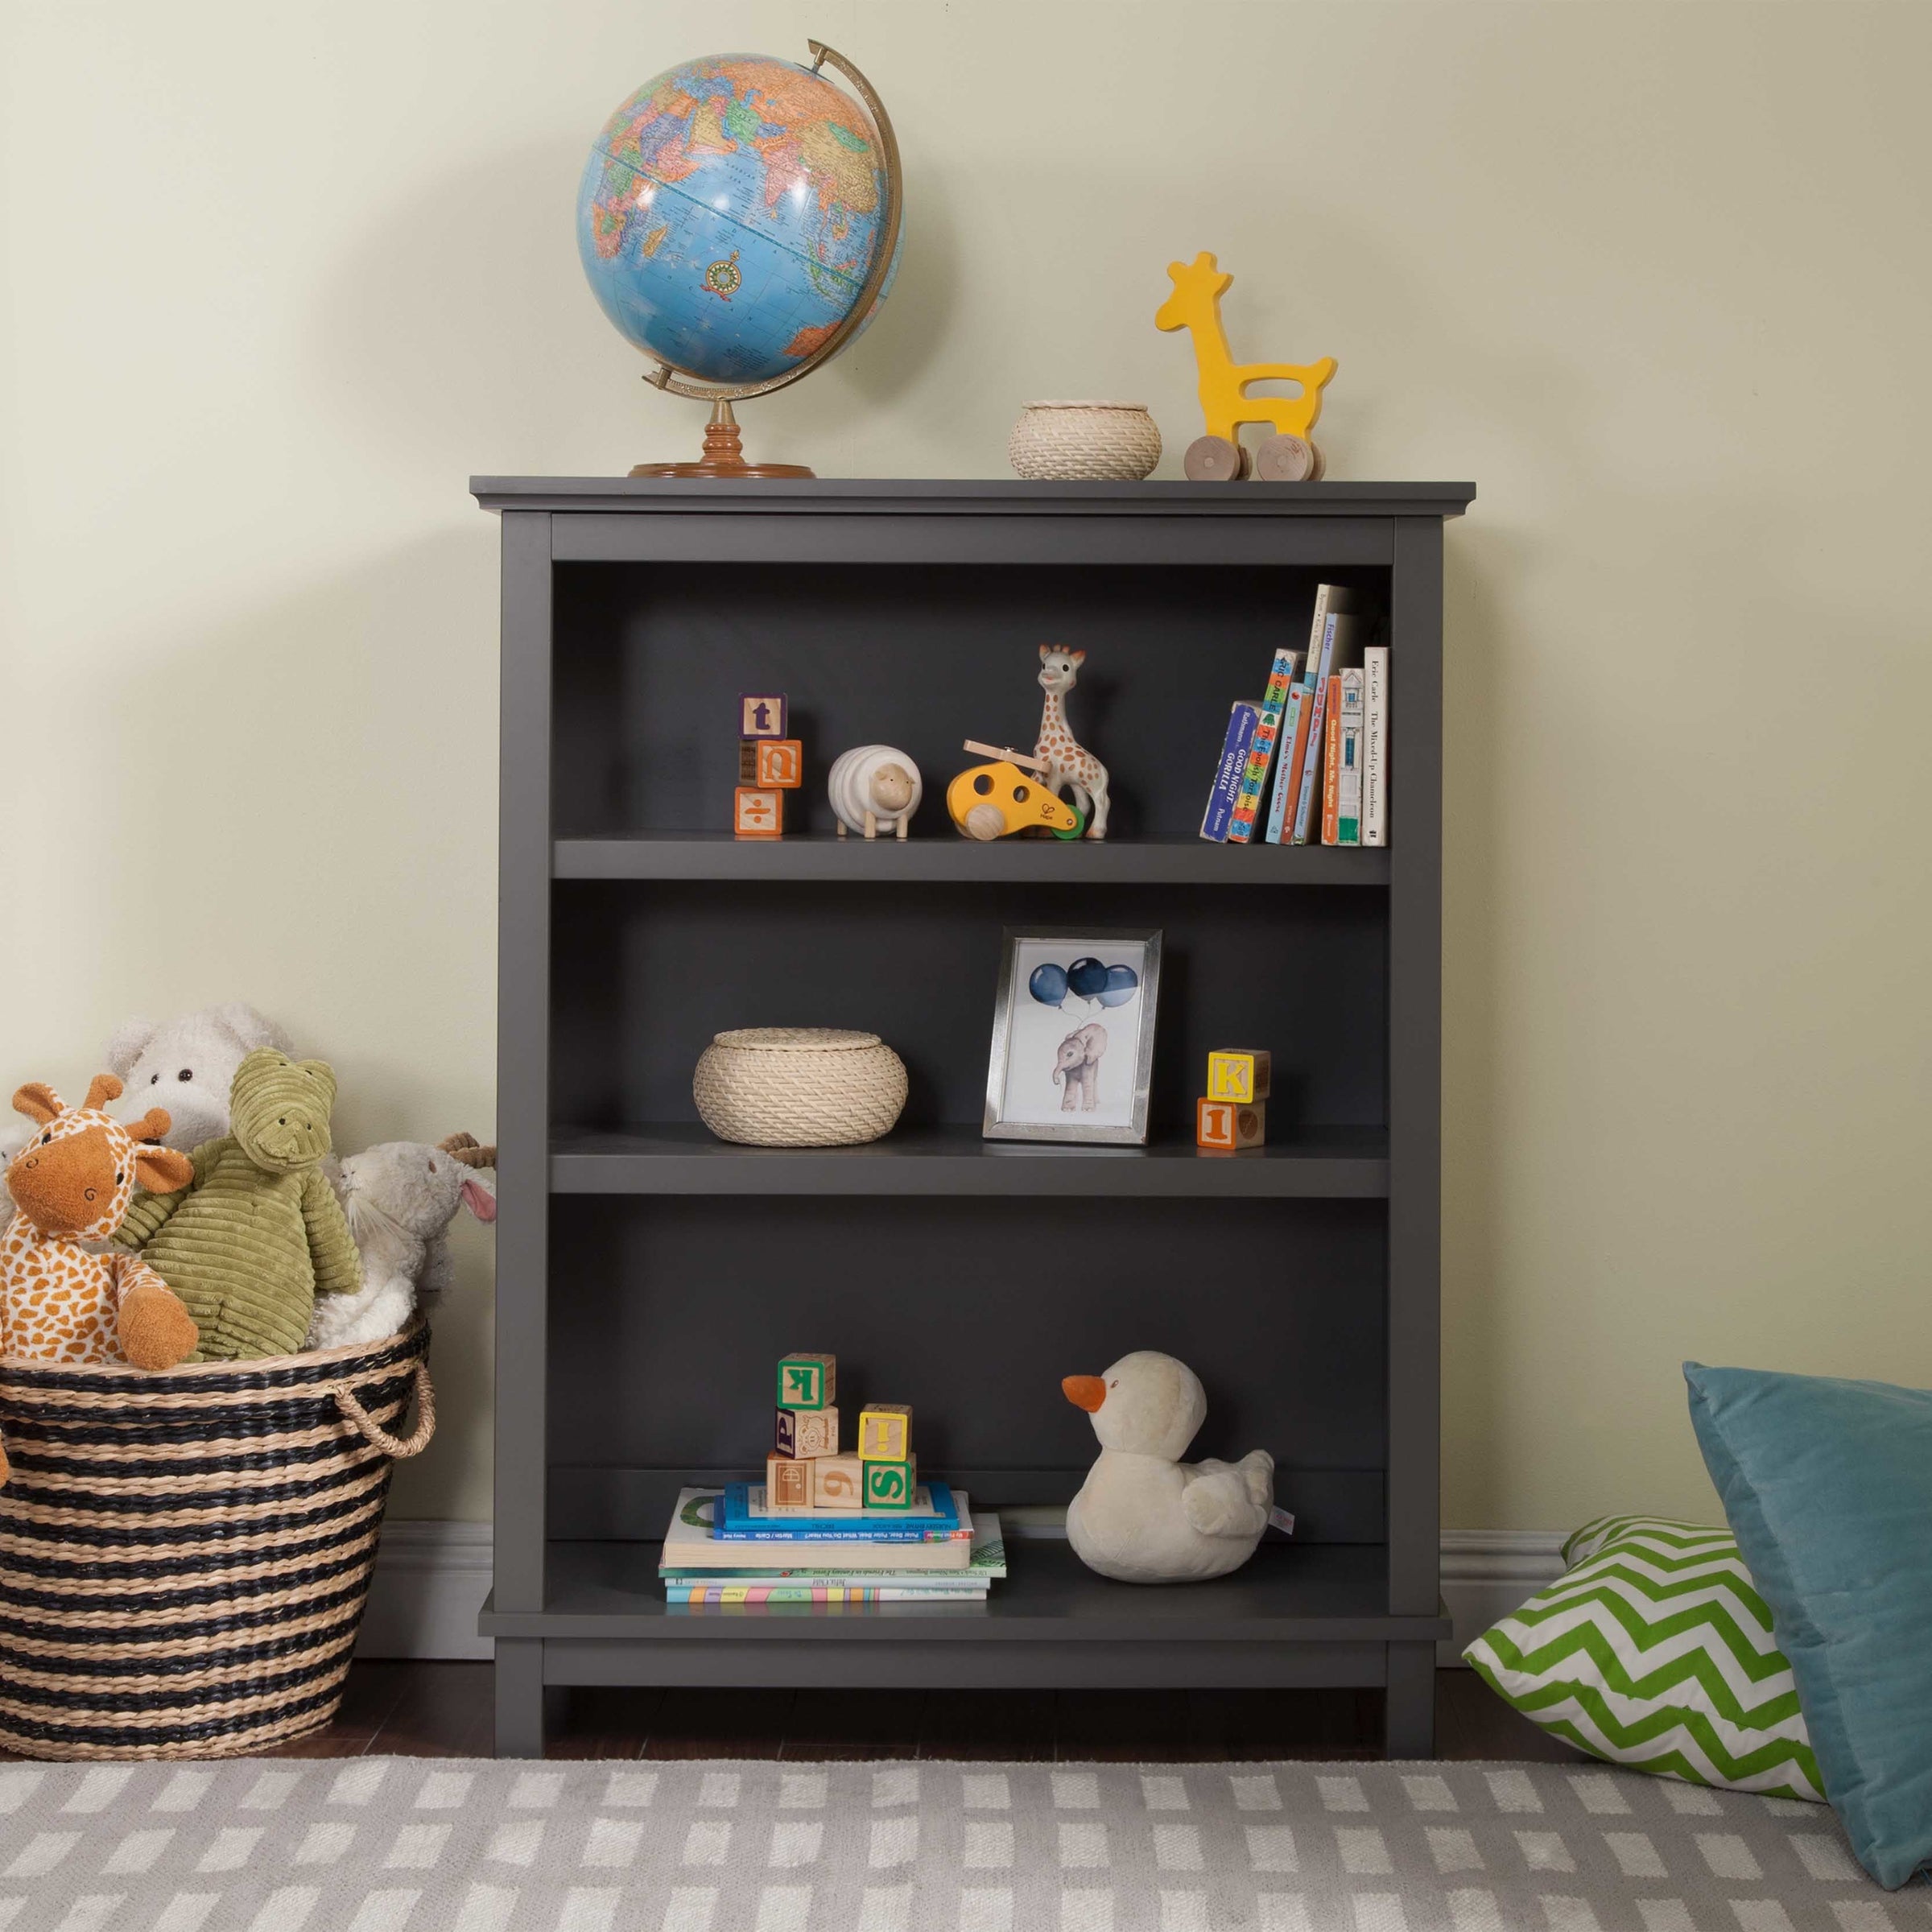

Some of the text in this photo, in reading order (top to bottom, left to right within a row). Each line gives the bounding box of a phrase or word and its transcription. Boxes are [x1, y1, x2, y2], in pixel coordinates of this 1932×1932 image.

[1324, 623, 1335, 650] Fischer
[1269, 680, 1282, 711] CARLE
[1370, 680, 1378, 703] Carle
[753, 702, 770, 730] t
[1236, 711, 1251, 742] Rathmann
[1370, 711, 1378, 727] The
[1261, 729, 1271, 745] The
[1368, 730, 1377, 770] Mixed-Up
[1232, 749, 1246, 774] GOOD
[1252, 745, 1266, 776] Foolish
[1328, 743, 1336, 768] Night,
[1219, 752, 1235, 791] GORILLA
[1274, 736, 1292, 814] Elmo's Mother Goose
[1242, 778, 1258, 811] Tortoise
[1368, 773, 1377, 819] Chameleon
[1213, 807, 1225, 832] Putnam
[1217, 1063, 1246, 1094] K
[871, 1470, 903, 1499] S
